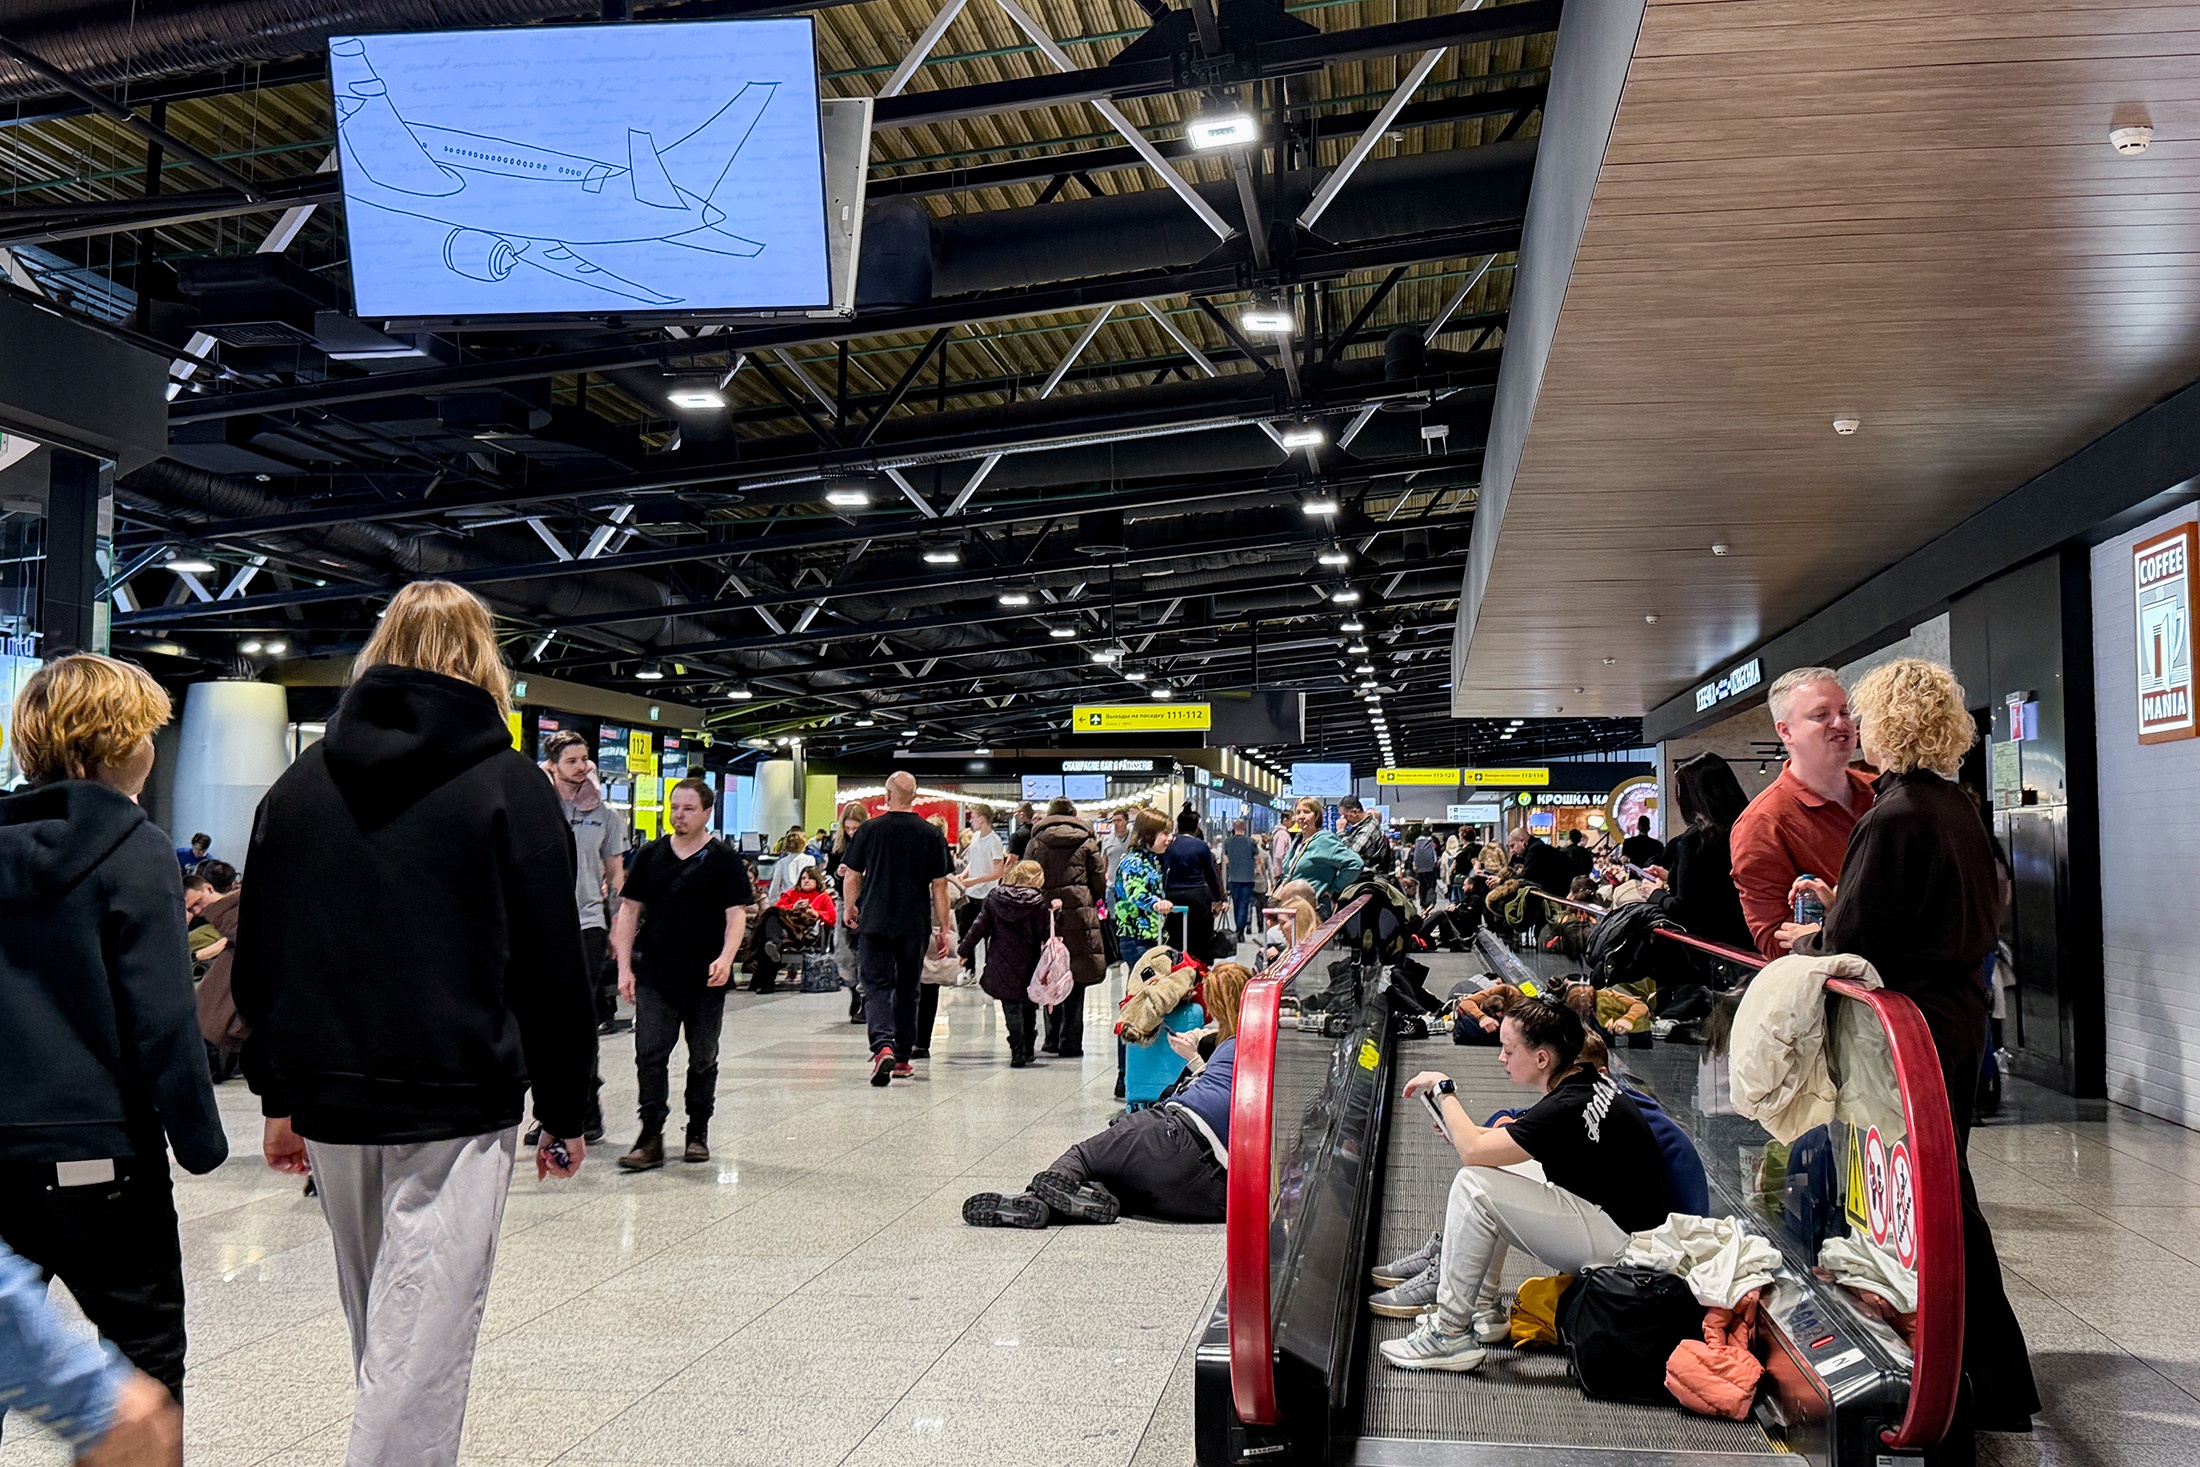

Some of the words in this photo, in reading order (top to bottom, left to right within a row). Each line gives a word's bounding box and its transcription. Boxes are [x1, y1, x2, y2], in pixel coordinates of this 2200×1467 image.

[2139, 546, 2184, 585] COFFEE
[2143, 690, 2187, 722] MANIA
[1166, 711, 1203, 719] 111-112
[632, 738, 645, 755] 112
[1536, 794, 1590, 805] КРОШКА
